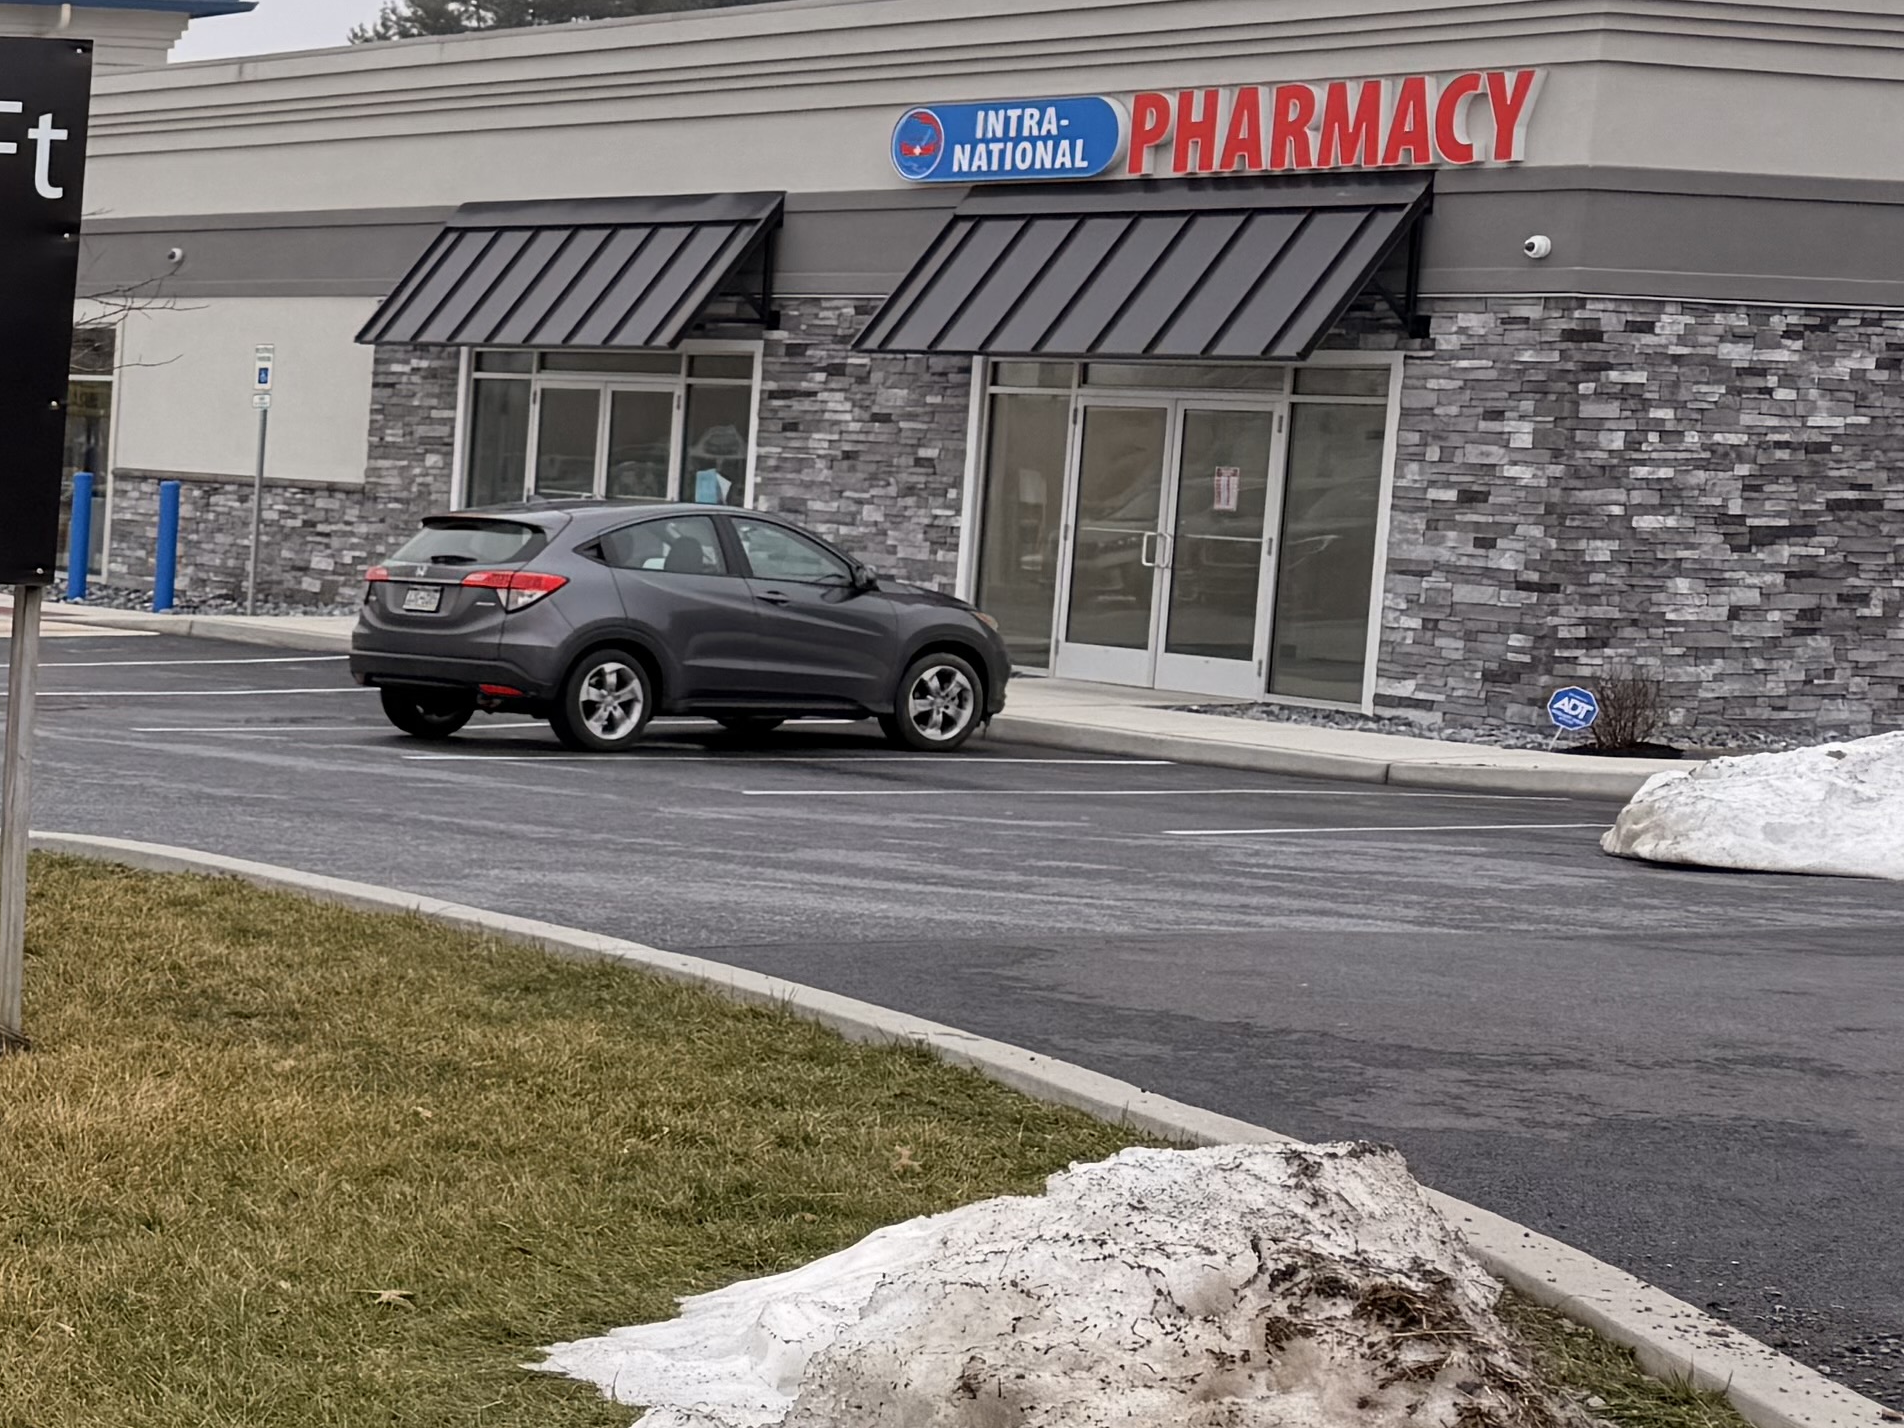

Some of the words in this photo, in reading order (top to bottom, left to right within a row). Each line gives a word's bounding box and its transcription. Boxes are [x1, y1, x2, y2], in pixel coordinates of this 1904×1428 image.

[975, 107, 1070, 139] INTRA-
[1127, 70, 1537, 174] PHARMACY
[952, 139, 1088, 173] NATIONAL
[1552, 696, 1594, 720] ADT
